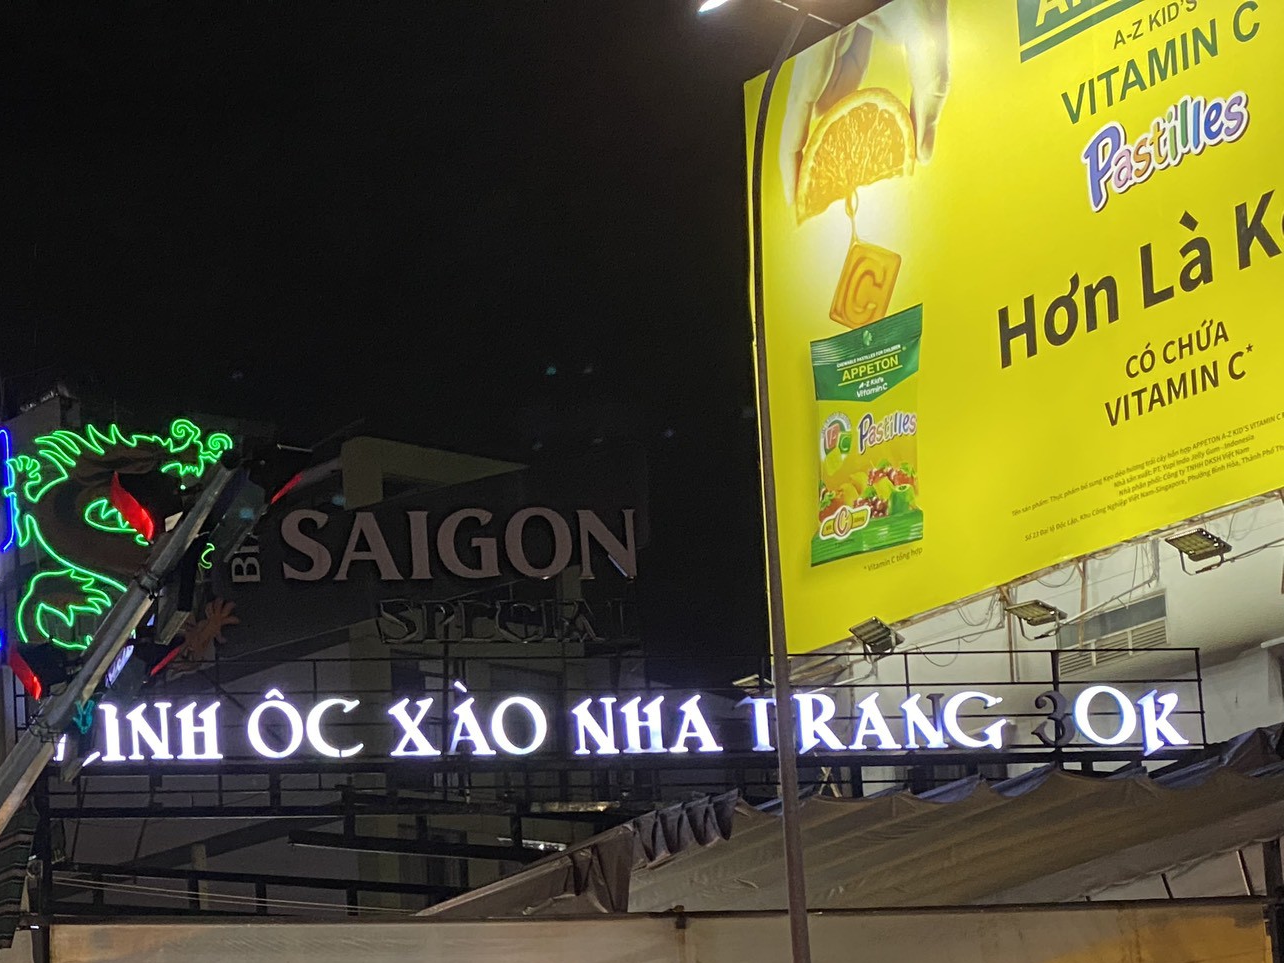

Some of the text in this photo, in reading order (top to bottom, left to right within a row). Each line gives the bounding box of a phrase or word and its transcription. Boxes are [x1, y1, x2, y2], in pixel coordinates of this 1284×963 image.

[1114, 0, 1197, 49] A-Z KID'S
[1061, 1, 1260, 125] VITAMIN C
[1082, 92, 1246, 211] Pastilles
[997, 189, 1284, 369] Hơn Là K
[842, 355, 899, 382] APPETON
[1125, 319, 1230, 379] CÓ CHỨA
[1104, 360, 1219, 427] VITAMIN
[858, 411, 917, 455] Pastilles
[1192, 434, 1221, 449] APPETON
[1249, 415, 1276, 431] VITAMIN
[281, 507, 637, 582] SAIGON
[53, 701, 224, 767] INH
[387, 680, 547, 757] XÀO
[570, 694, 724, 755] NHA
[739, 691, 1010, 757] TRANG
